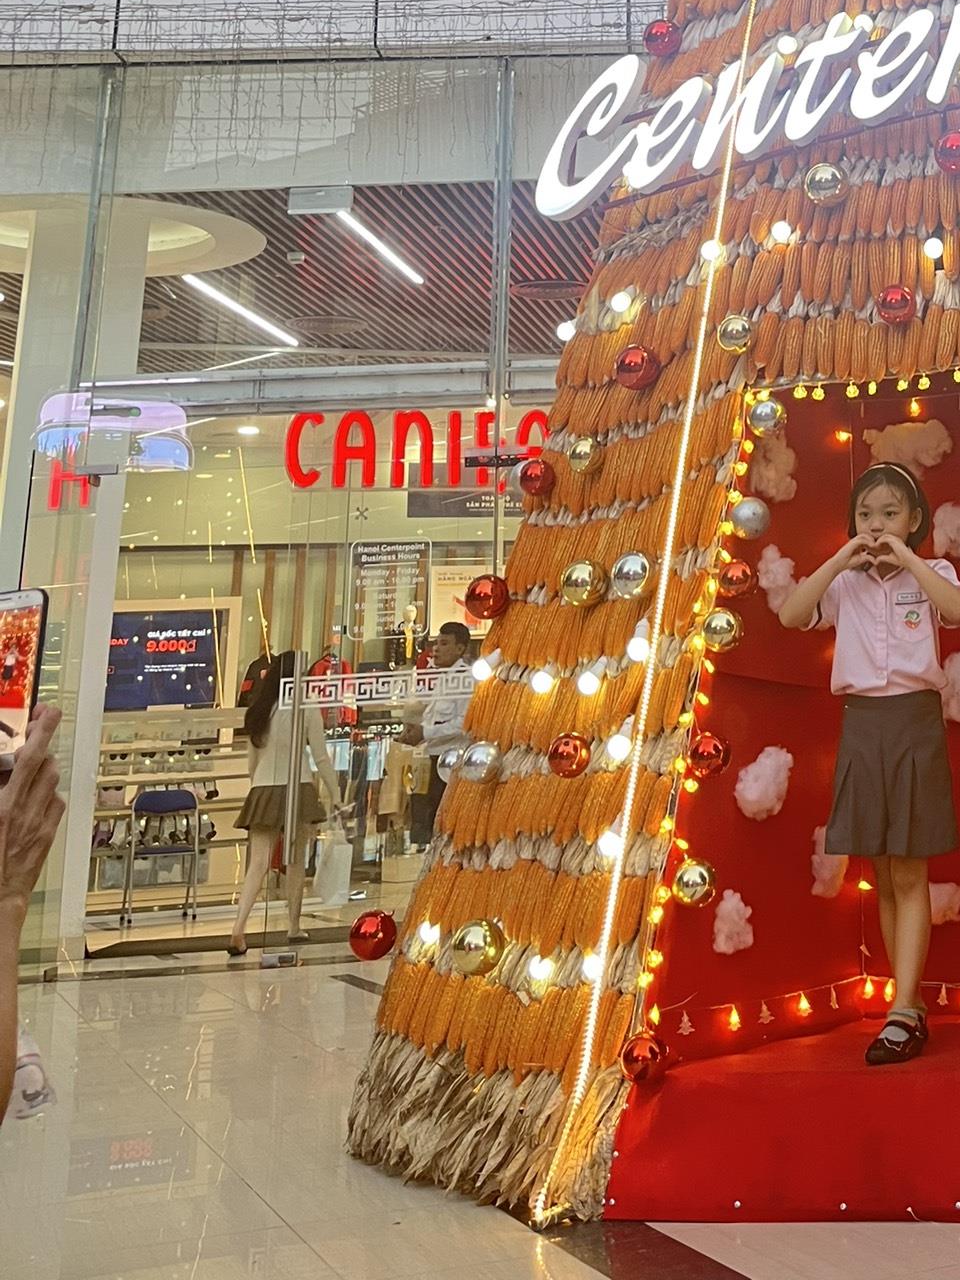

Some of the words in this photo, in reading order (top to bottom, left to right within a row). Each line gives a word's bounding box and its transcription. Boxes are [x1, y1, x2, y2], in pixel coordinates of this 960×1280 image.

[357, 545, 380, 553] Hanoi
[381, 543, 425, 552] Centerpoint
[361, 554, 397, 562] Business
[397, 552, 421, 560] Hours
